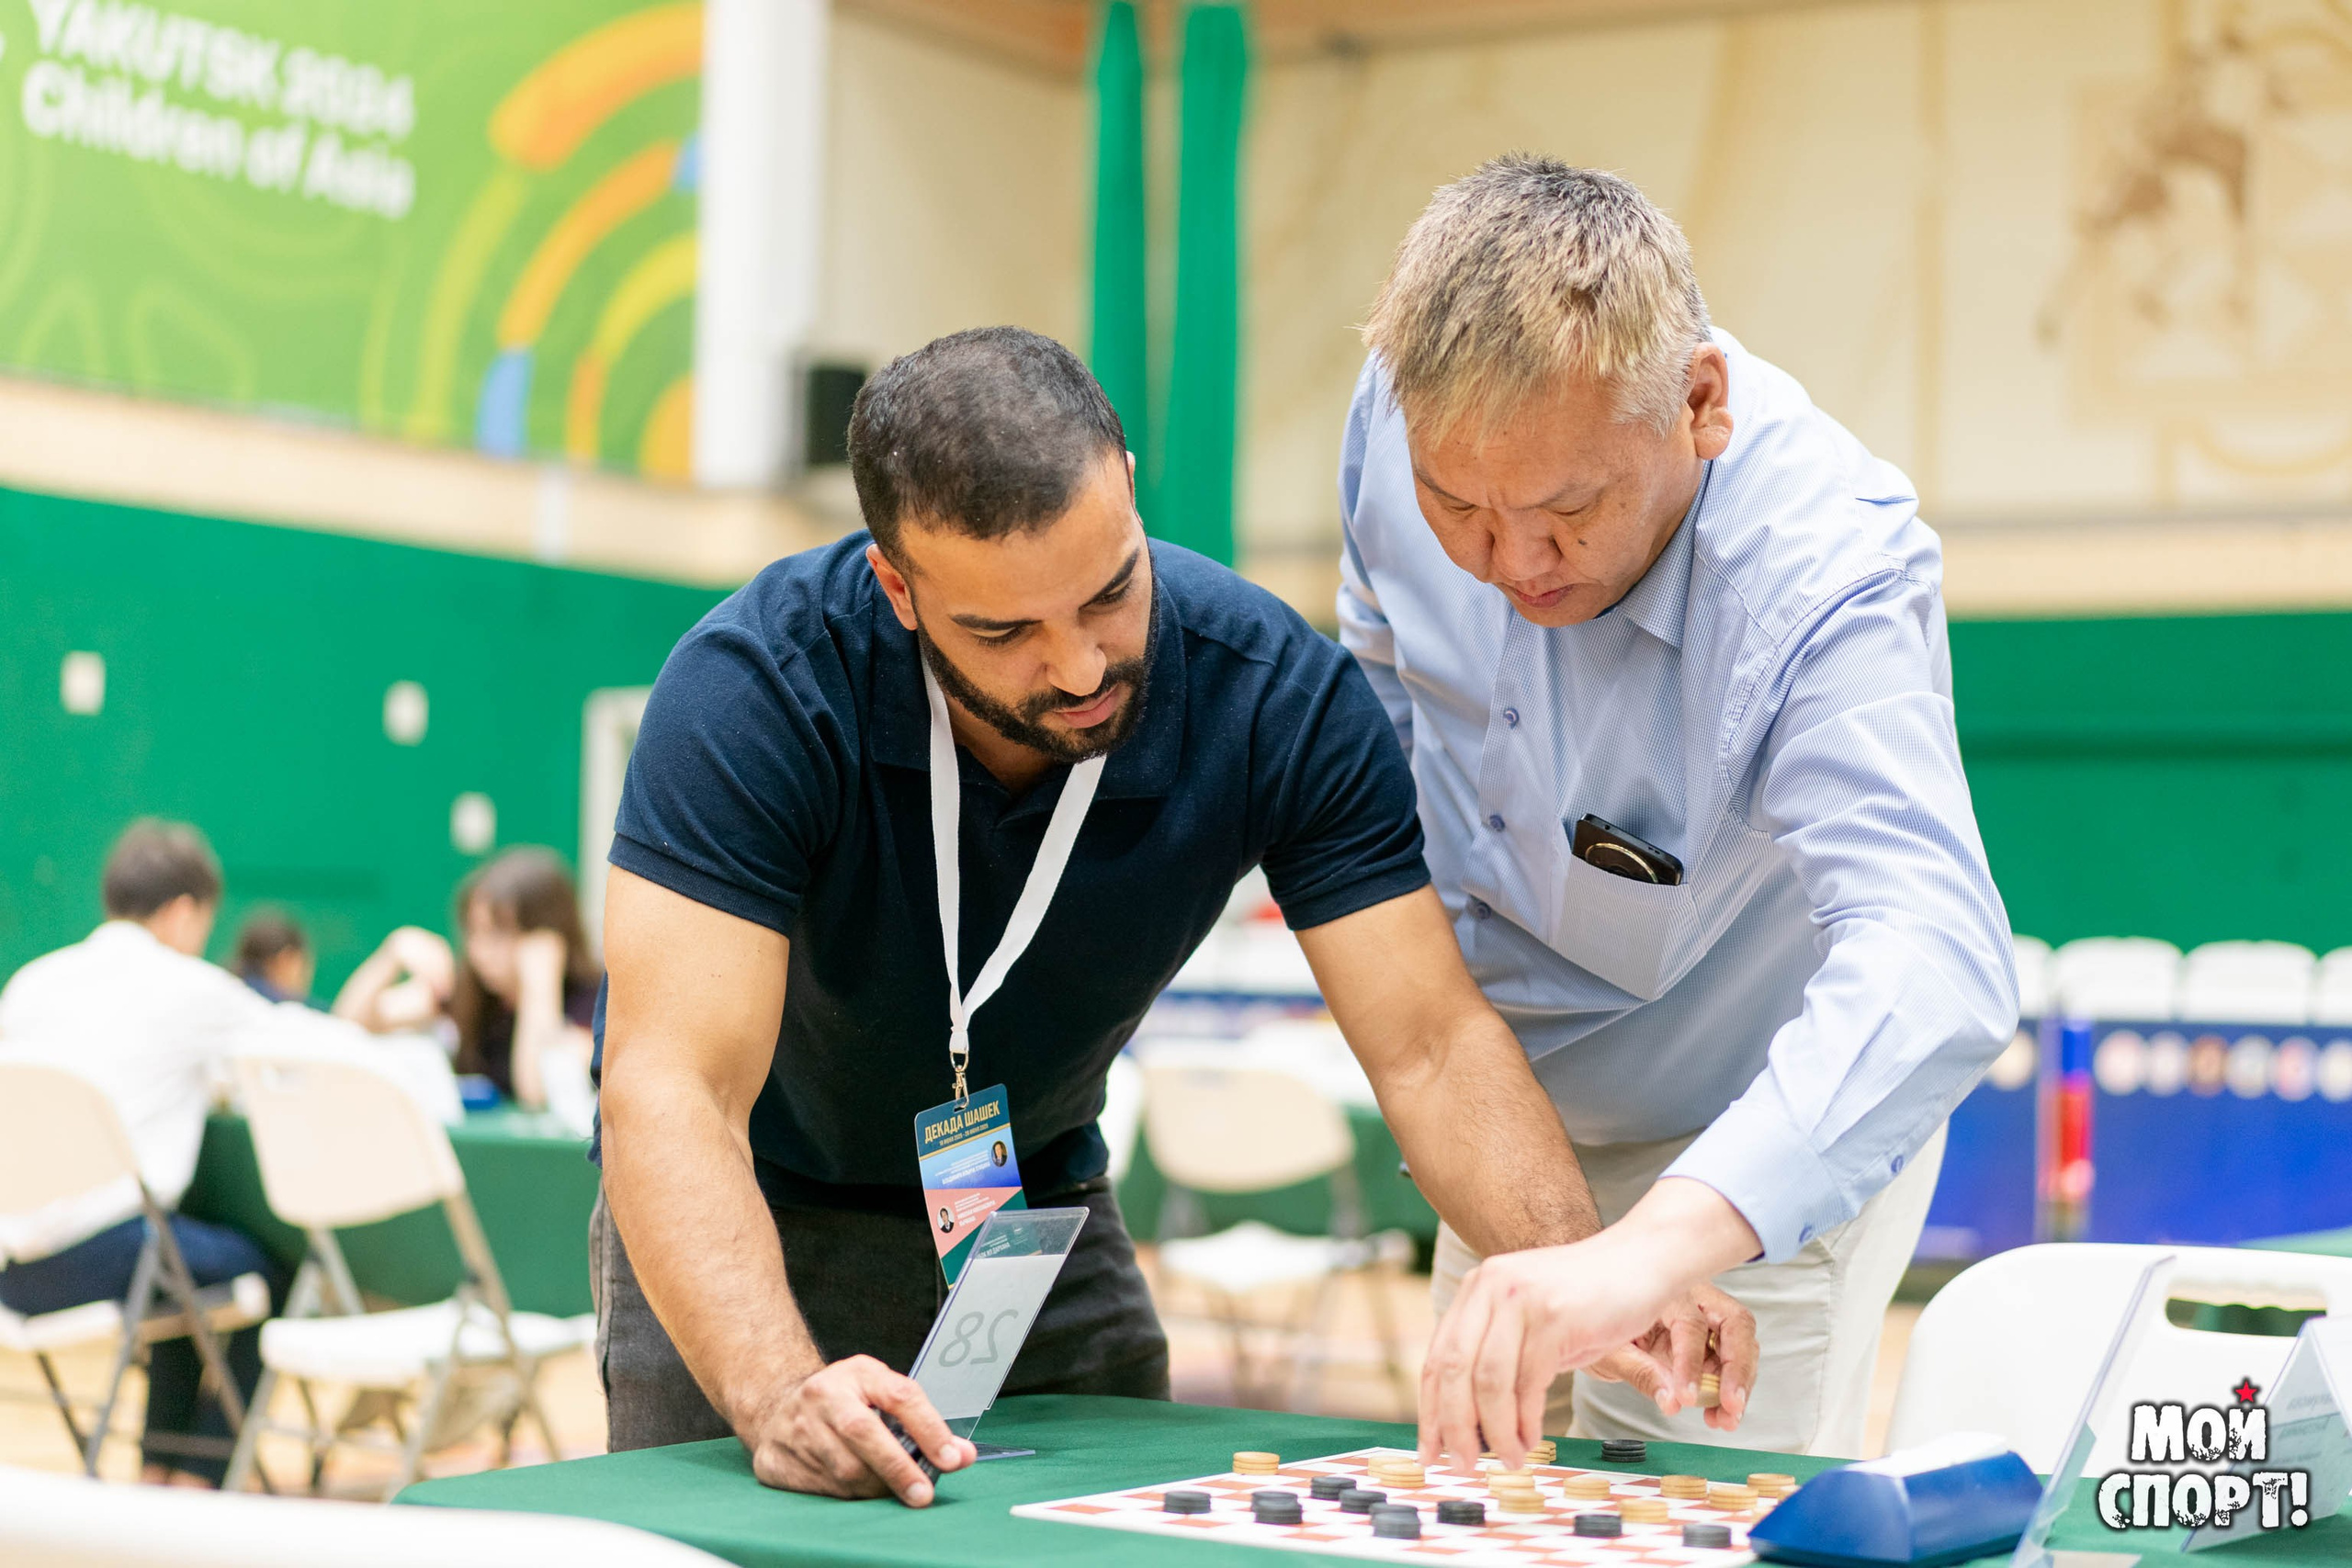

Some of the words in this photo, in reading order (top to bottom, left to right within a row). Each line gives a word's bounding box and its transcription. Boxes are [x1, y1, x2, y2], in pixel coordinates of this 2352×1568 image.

[28, 0, 282, 109] YAKUTSK
[22, 60, 243, 181] Children
[246, 118, 310, 194] of
[303, 130, 415, 220] Asia
[924, 1114, 964, 1145] ДЕКАДА
[964, 1100, 1001, 1128] ШАШЕК
